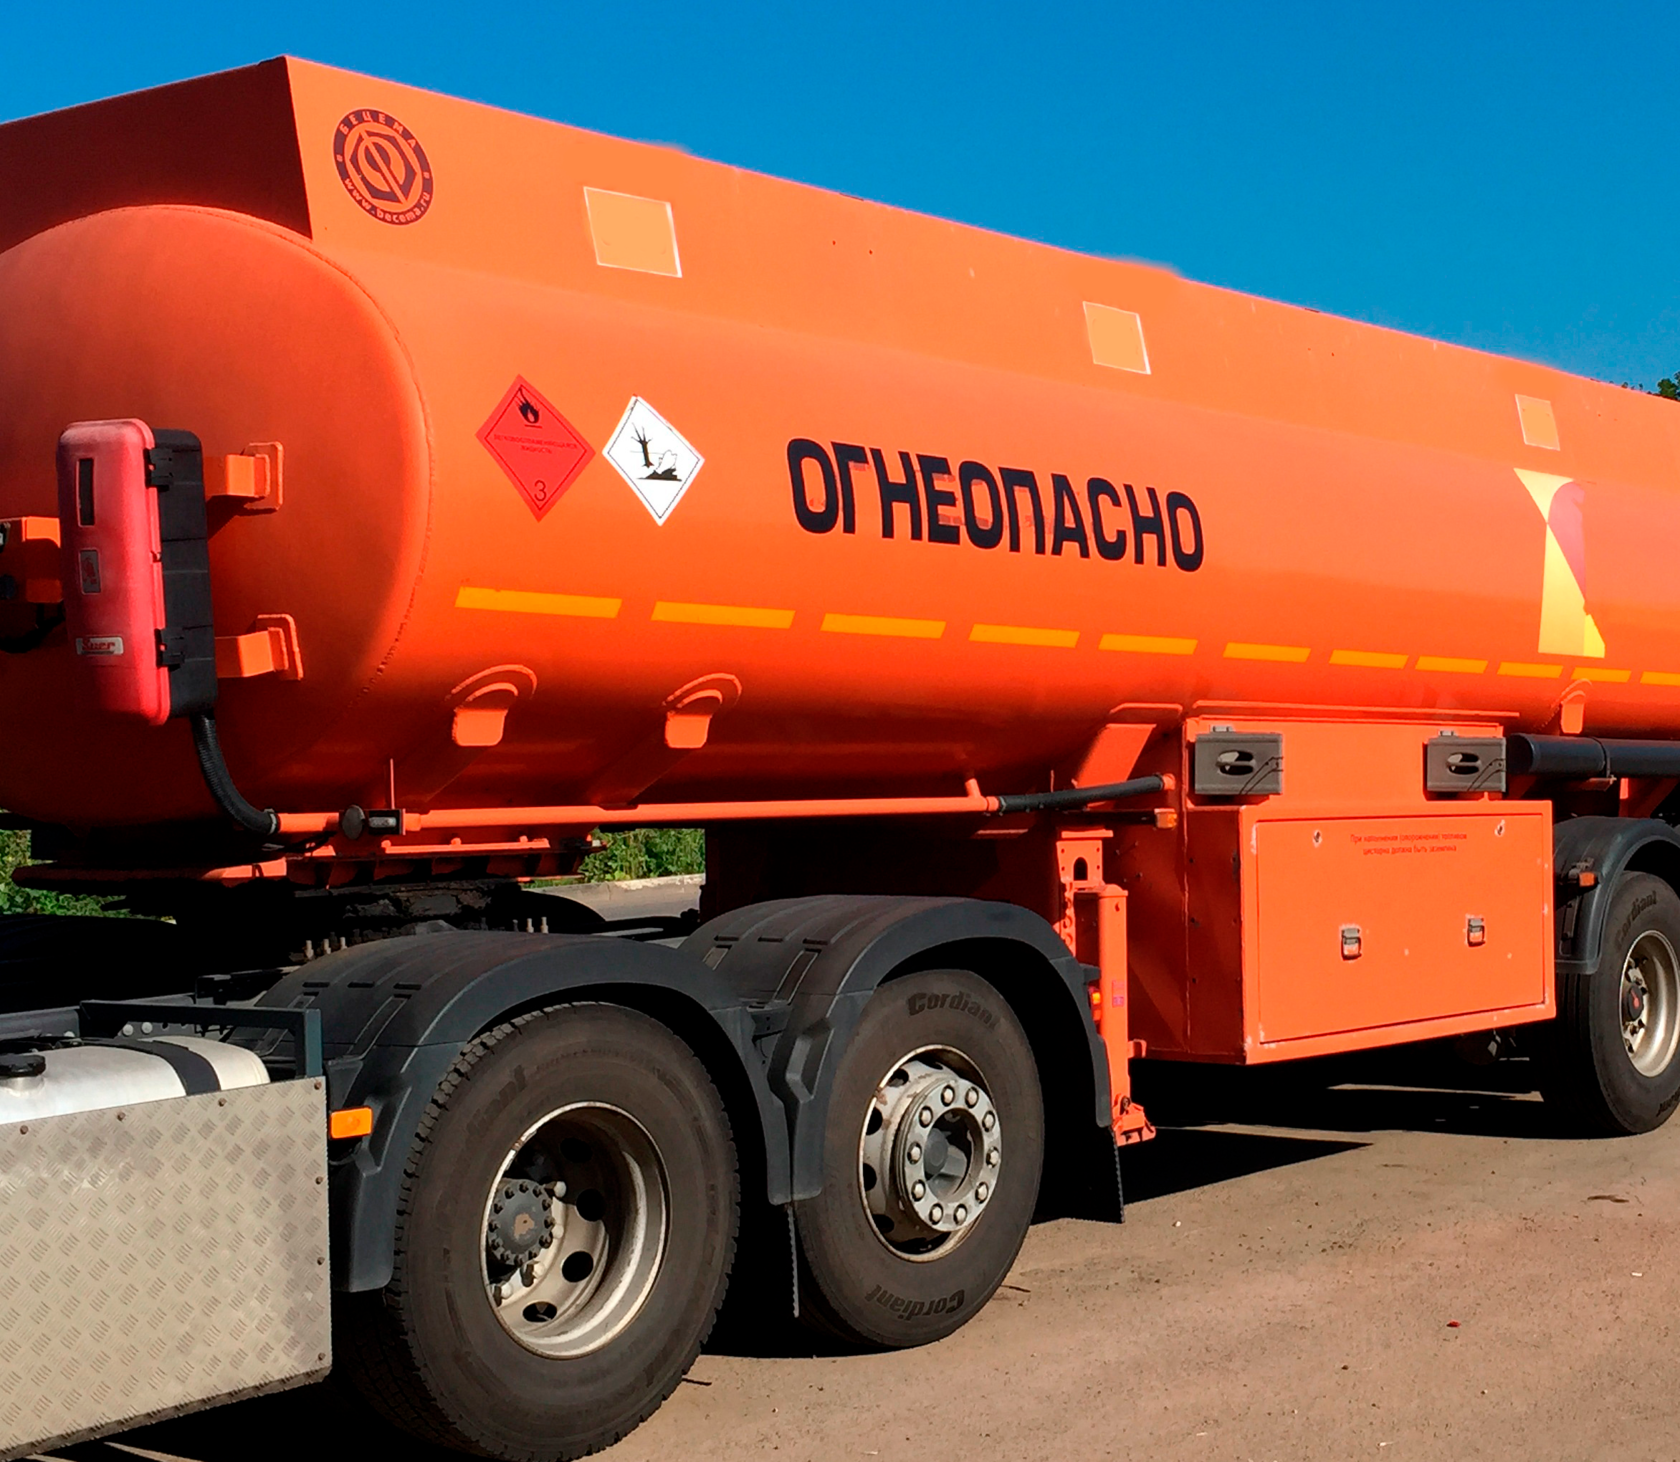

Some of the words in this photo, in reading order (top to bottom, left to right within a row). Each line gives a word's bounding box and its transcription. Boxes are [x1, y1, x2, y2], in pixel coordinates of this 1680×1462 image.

[340, 111, 417, 148] БЕЦЕМА
[345, 178, 430, 222] www.becema.ru
[534, 480, 547, 502] 3
[787, 438, 1204, 572] ОГНЕОПАСНО
